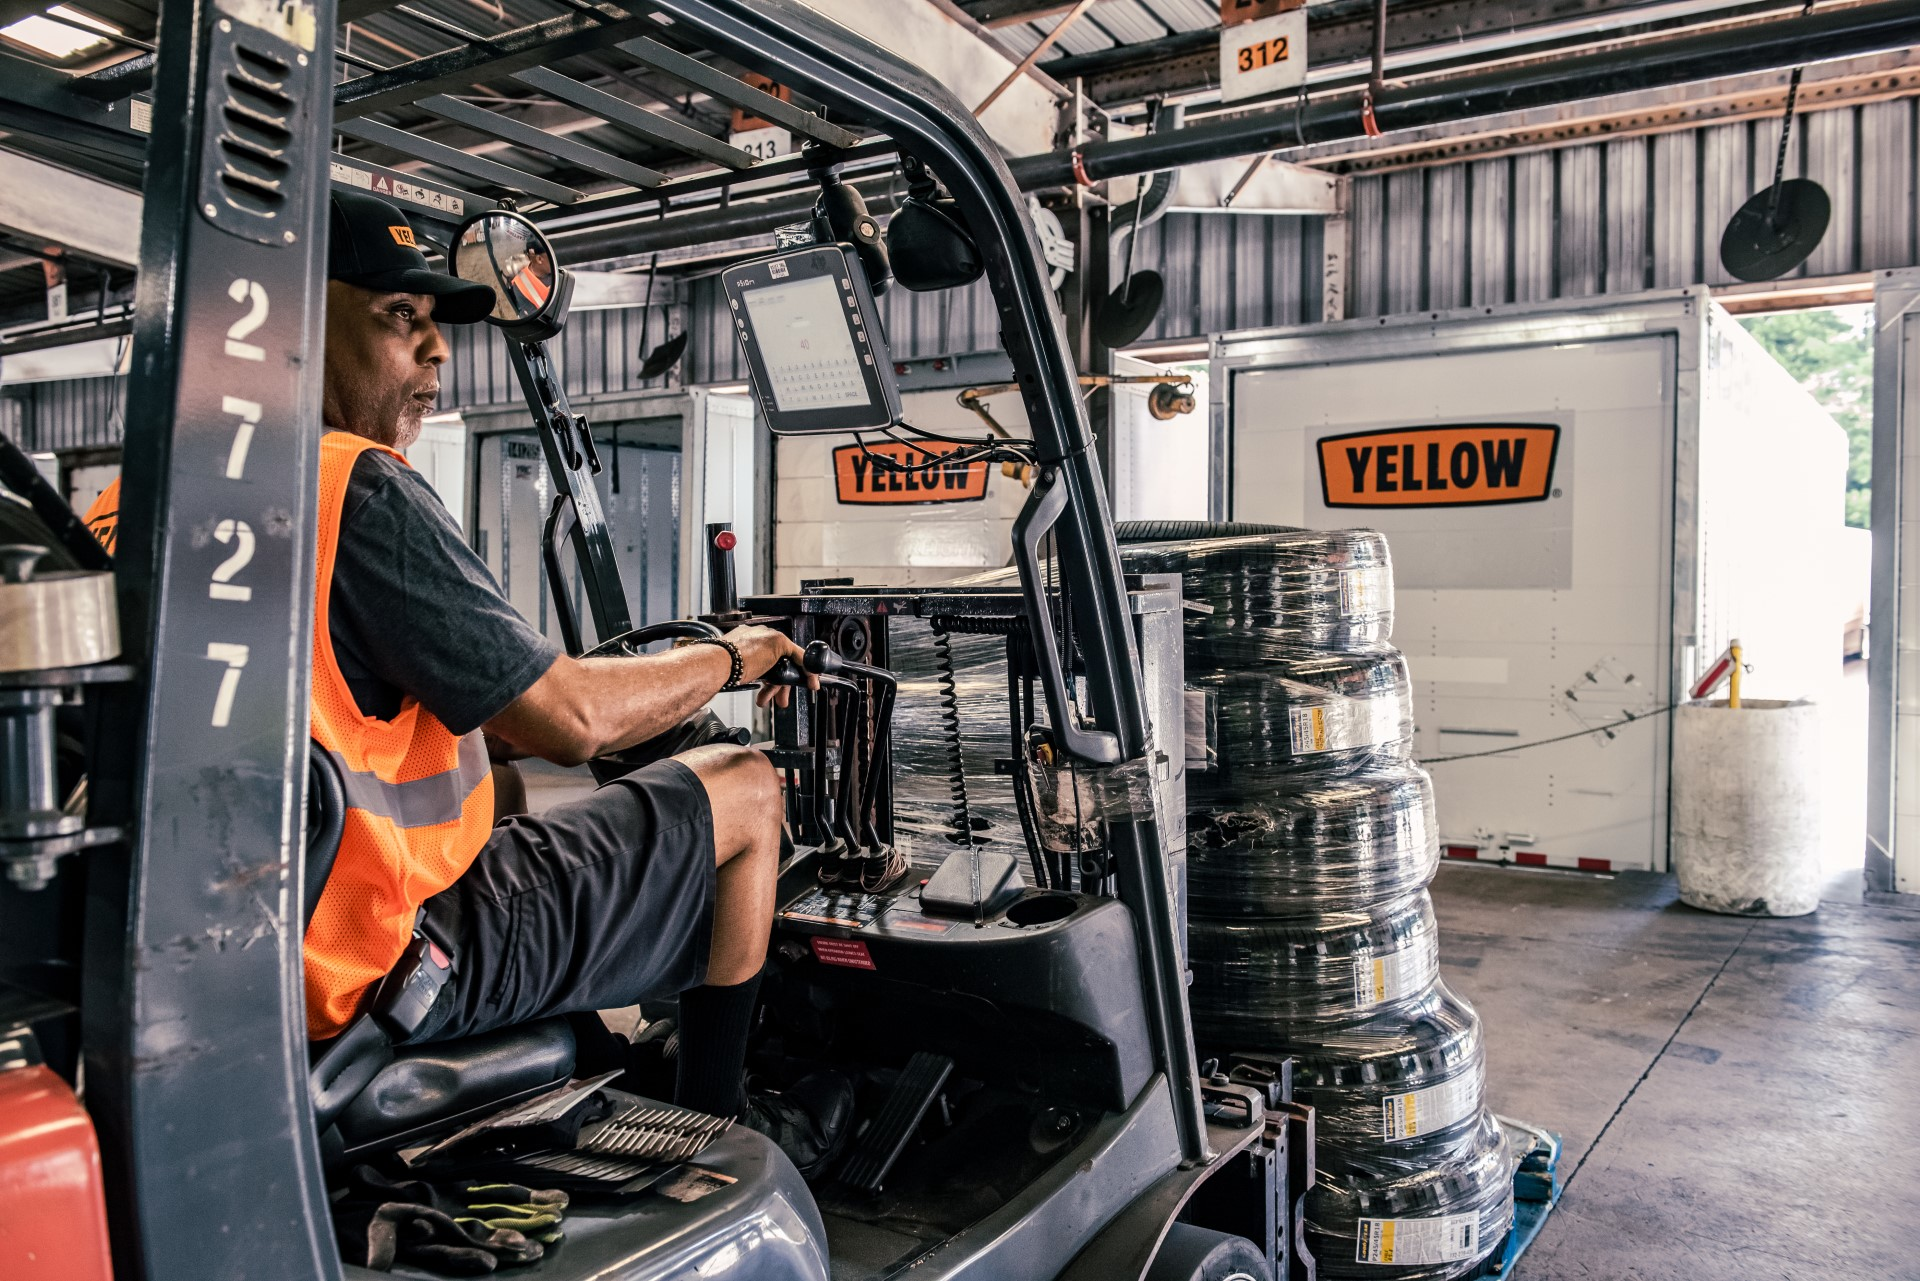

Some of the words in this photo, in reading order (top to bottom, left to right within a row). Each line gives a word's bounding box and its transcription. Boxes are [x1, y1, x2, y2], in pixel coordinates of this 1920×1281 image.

[1239, 37, 1288, 72] 312
[395, 229, 413, 244] YEL
[800, 338, 810, 350] 40
[851, 450, 970, 493] YELLOW
[1345, 438, 1527, 493] YELLOW
[1302, 713, 1310, 749] 245/45R18
[1372, 1222, 1380, 1262] P245/45R18
